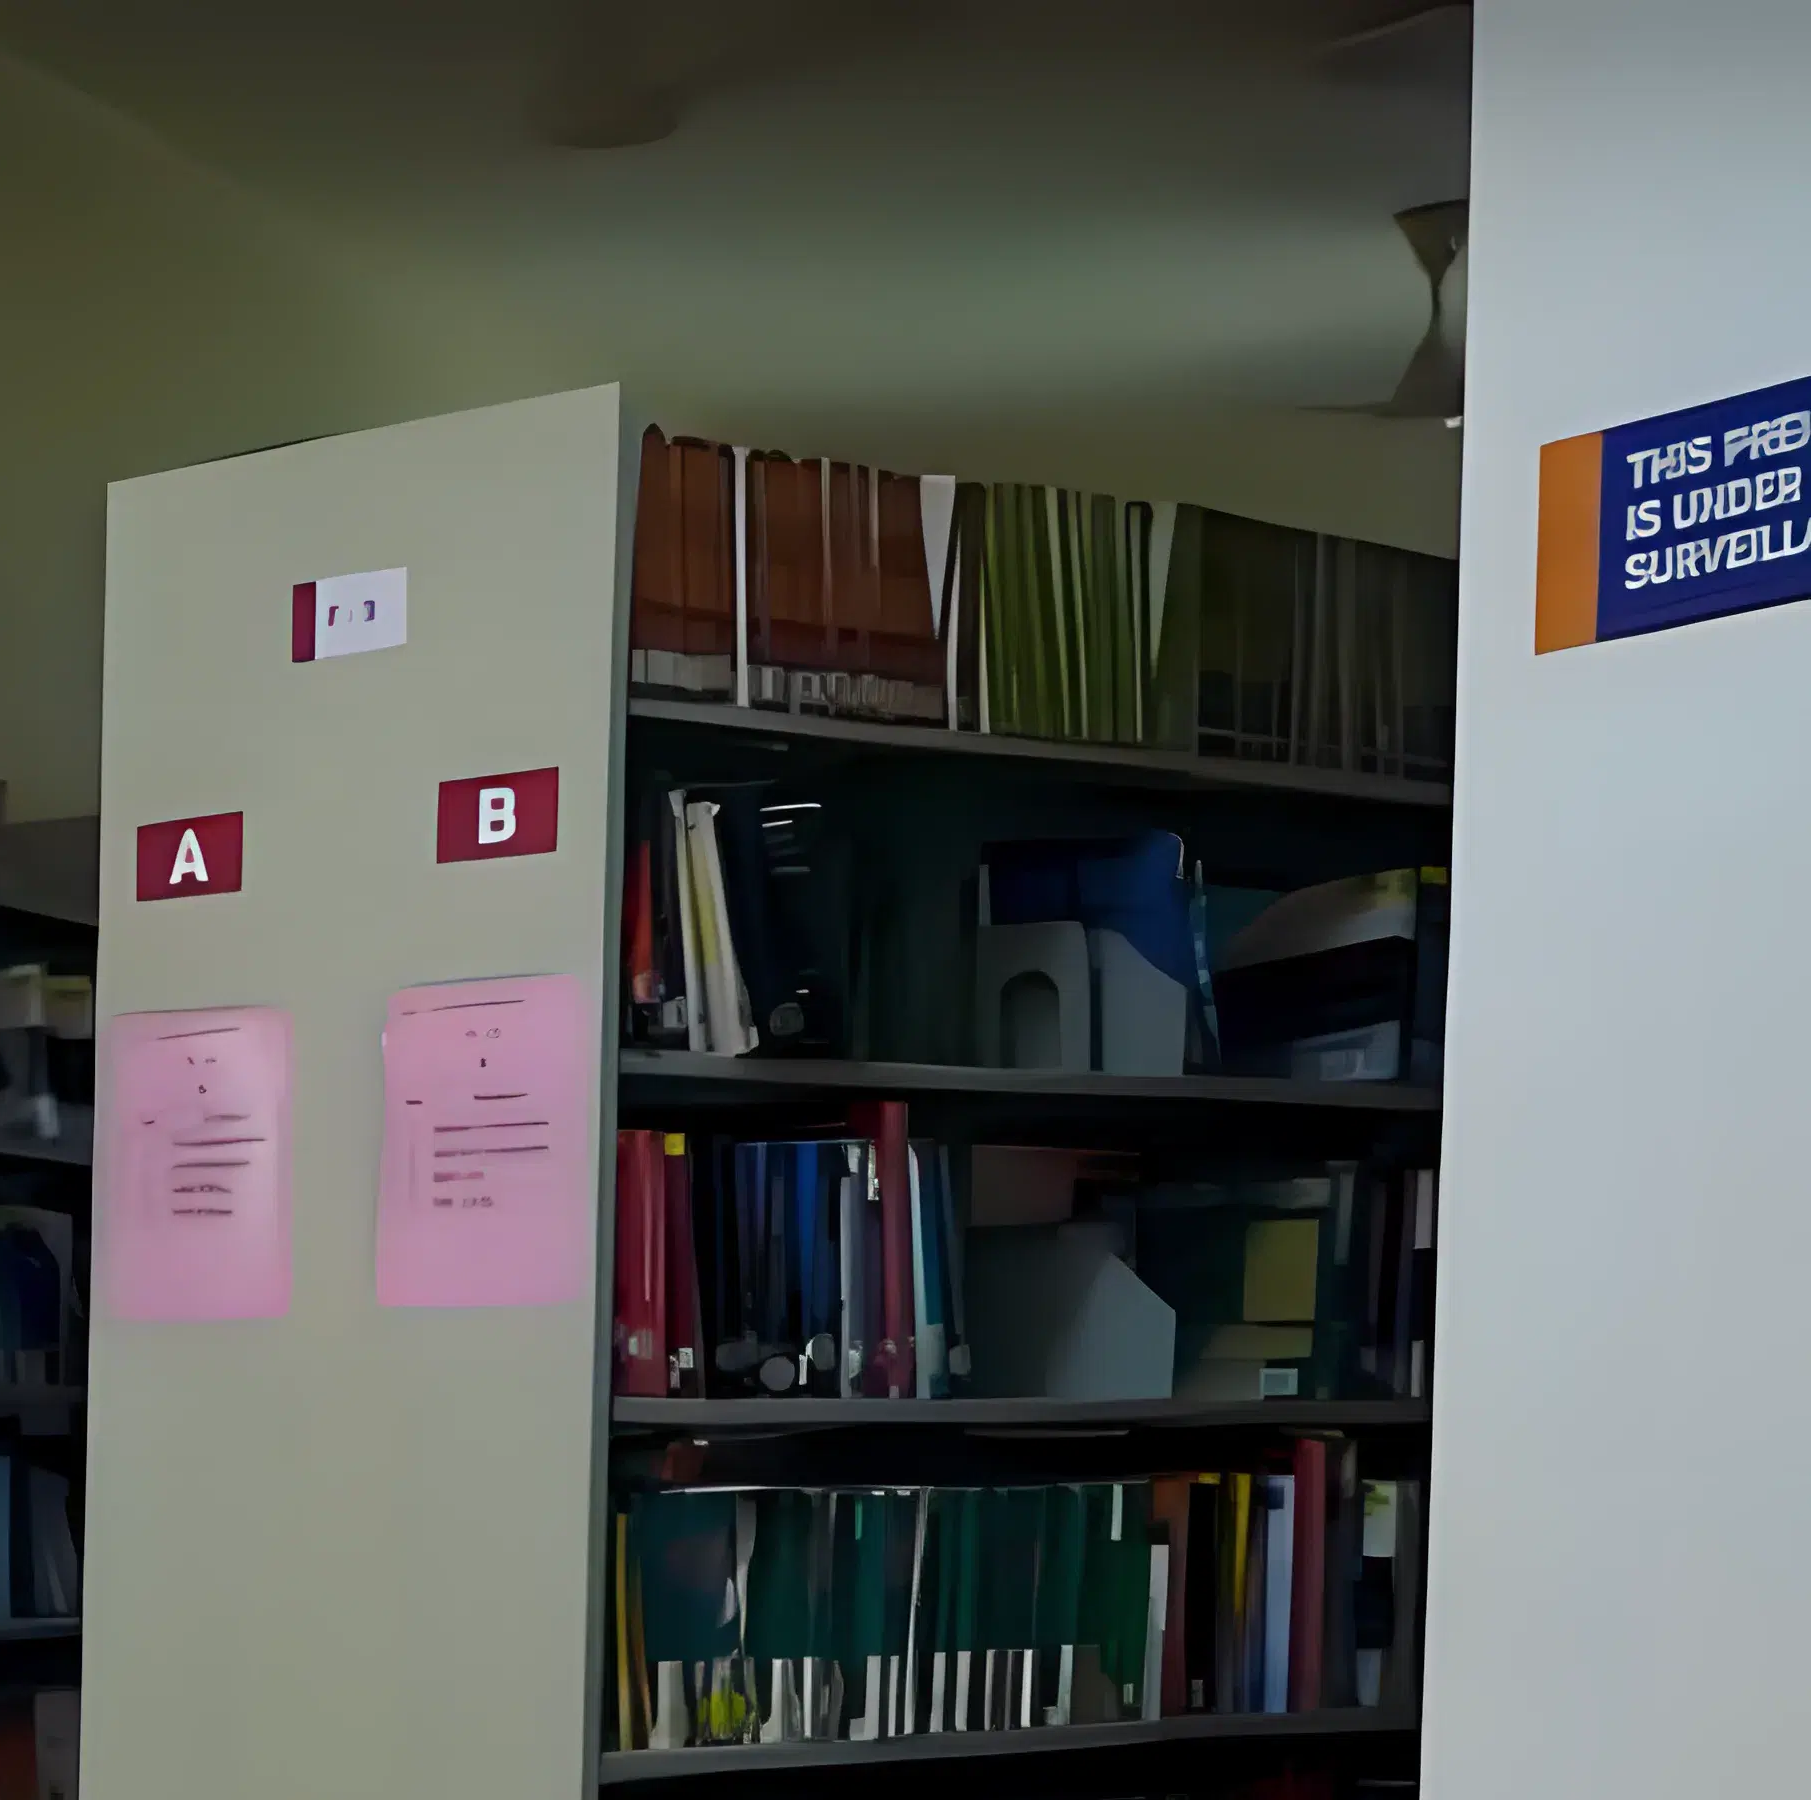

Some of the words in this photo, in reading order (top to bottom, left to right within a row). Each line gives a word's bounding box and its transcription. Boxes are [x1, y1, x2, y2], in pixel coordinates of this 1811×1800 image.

[1625, 433, 1713, 490] THIS
[1625, 499, 1662, 542] IS
[1673, 465, 1803, 530] UNDER
[477, 786, 517, 845] B
[168, 827, 210, 885] A
